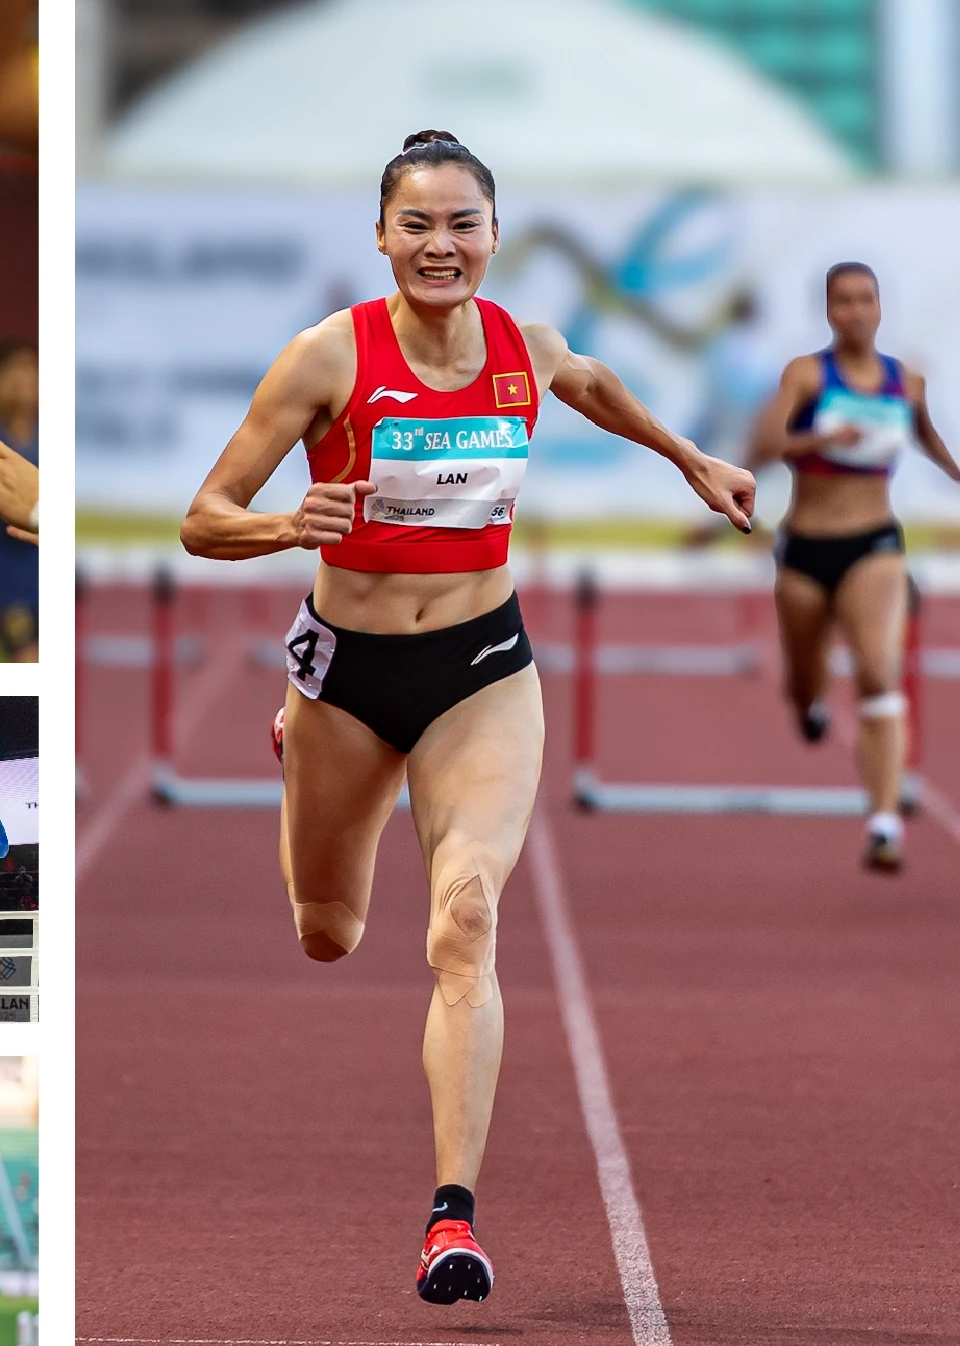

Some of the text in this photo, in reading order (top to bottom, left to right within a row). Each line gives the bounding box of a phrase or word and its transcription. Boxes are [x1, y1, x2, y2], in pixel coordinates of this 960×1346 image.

[424, 431, 451, 450] SEA
[456, 430, 512, 449] GAMES
[436, 473, 468, 484] LAN
[386, 506, 435, 516] THAILAND
[288, 629, 319, 681] 4
